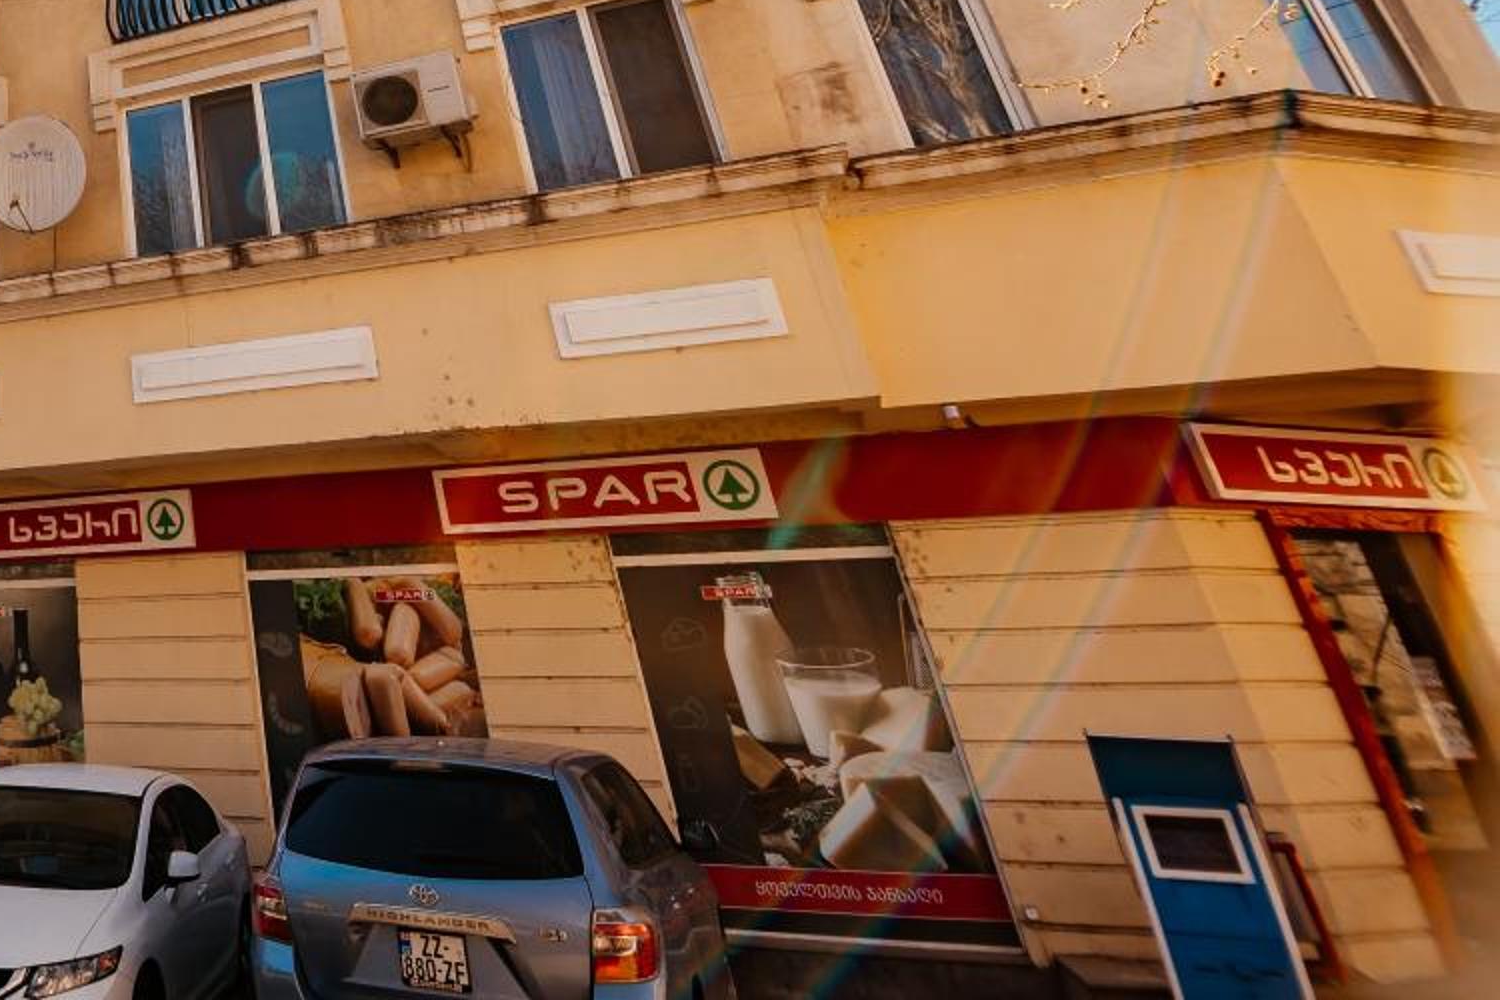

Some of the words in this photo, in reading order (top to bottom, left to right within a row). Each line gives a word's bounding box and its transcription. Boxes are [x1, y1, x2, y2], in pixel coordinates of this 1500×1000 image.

[499, 469, 691, 513] SPAR
[386, 590, 421, 600] SPAR
[366, 909, 491, 931] HIGHLANDER
[403, 955, 466, 986] 880-ZF
